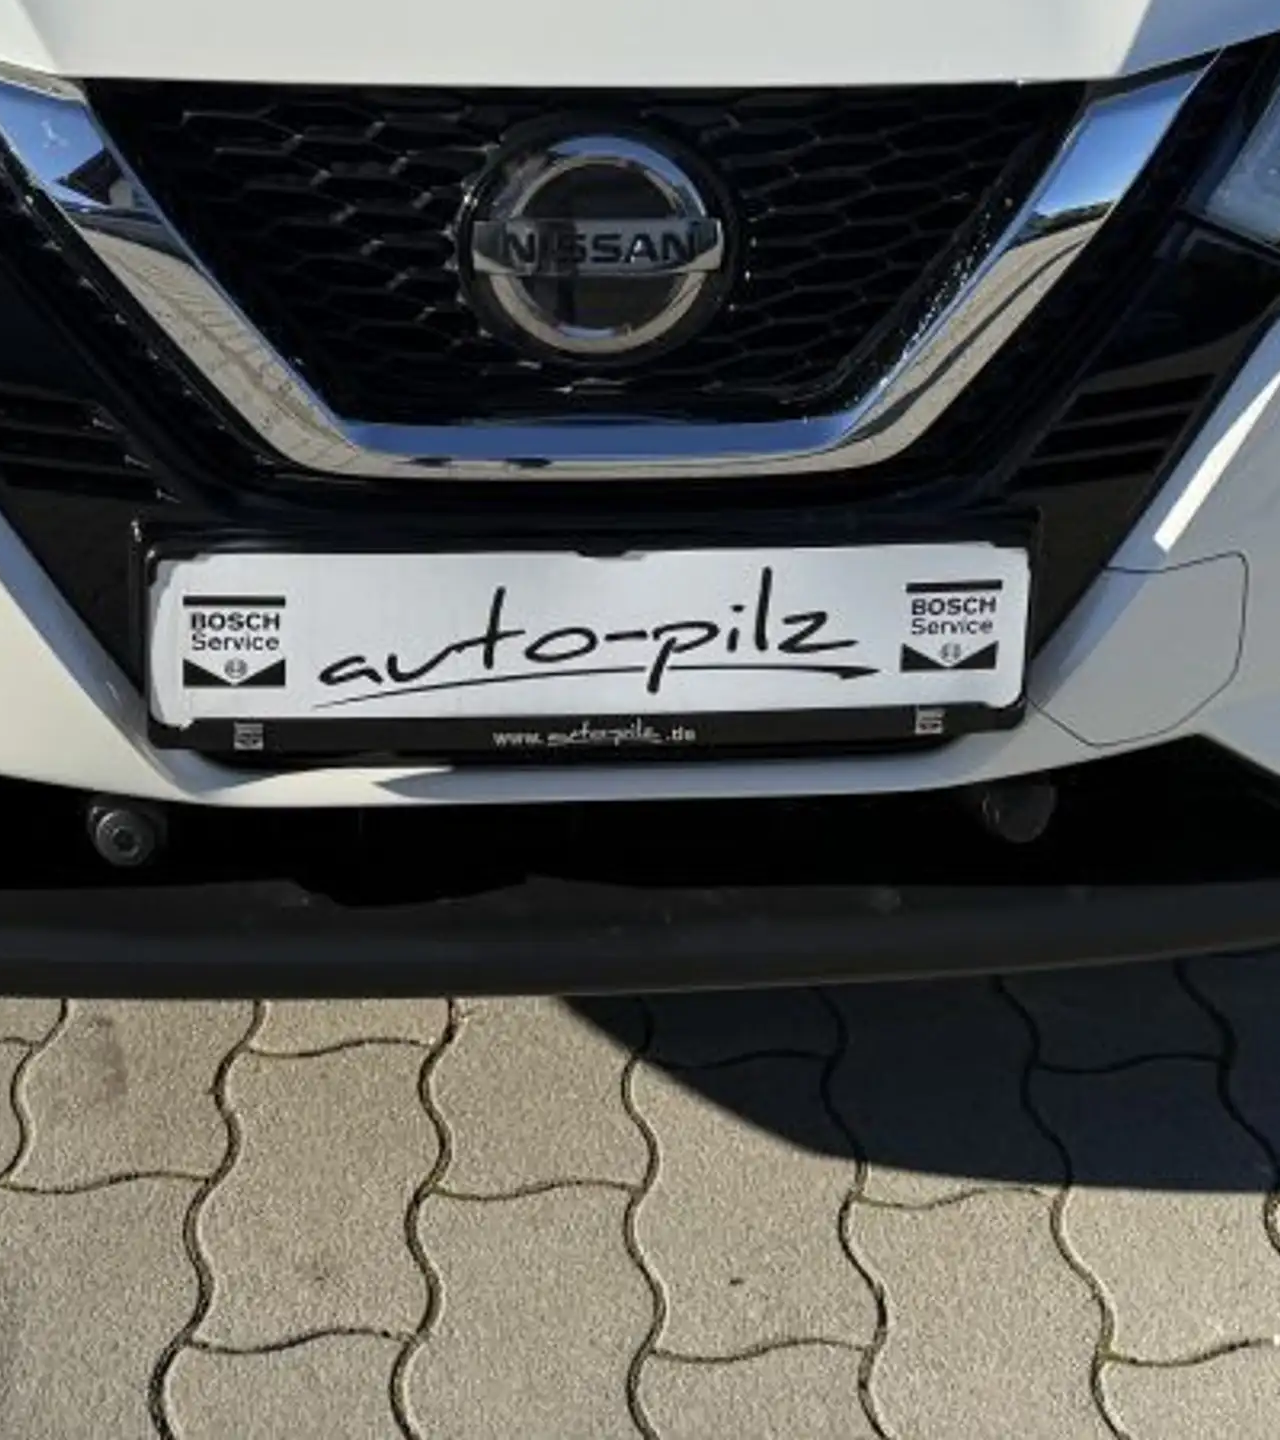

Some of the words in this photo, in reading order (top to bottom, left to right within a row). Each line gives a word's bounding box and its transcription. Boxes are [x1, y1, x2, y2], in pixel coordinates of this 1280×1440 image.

[502, 232, 696, 264] NISSAN
[911, 595, 998, 616] BOSCH
[190, 611, 281, 632] BOSCH
[318, 566, 859, 694] auto-pilz
[911, 616, 995, 636] Service
[190, 633, 280, 651] Service
